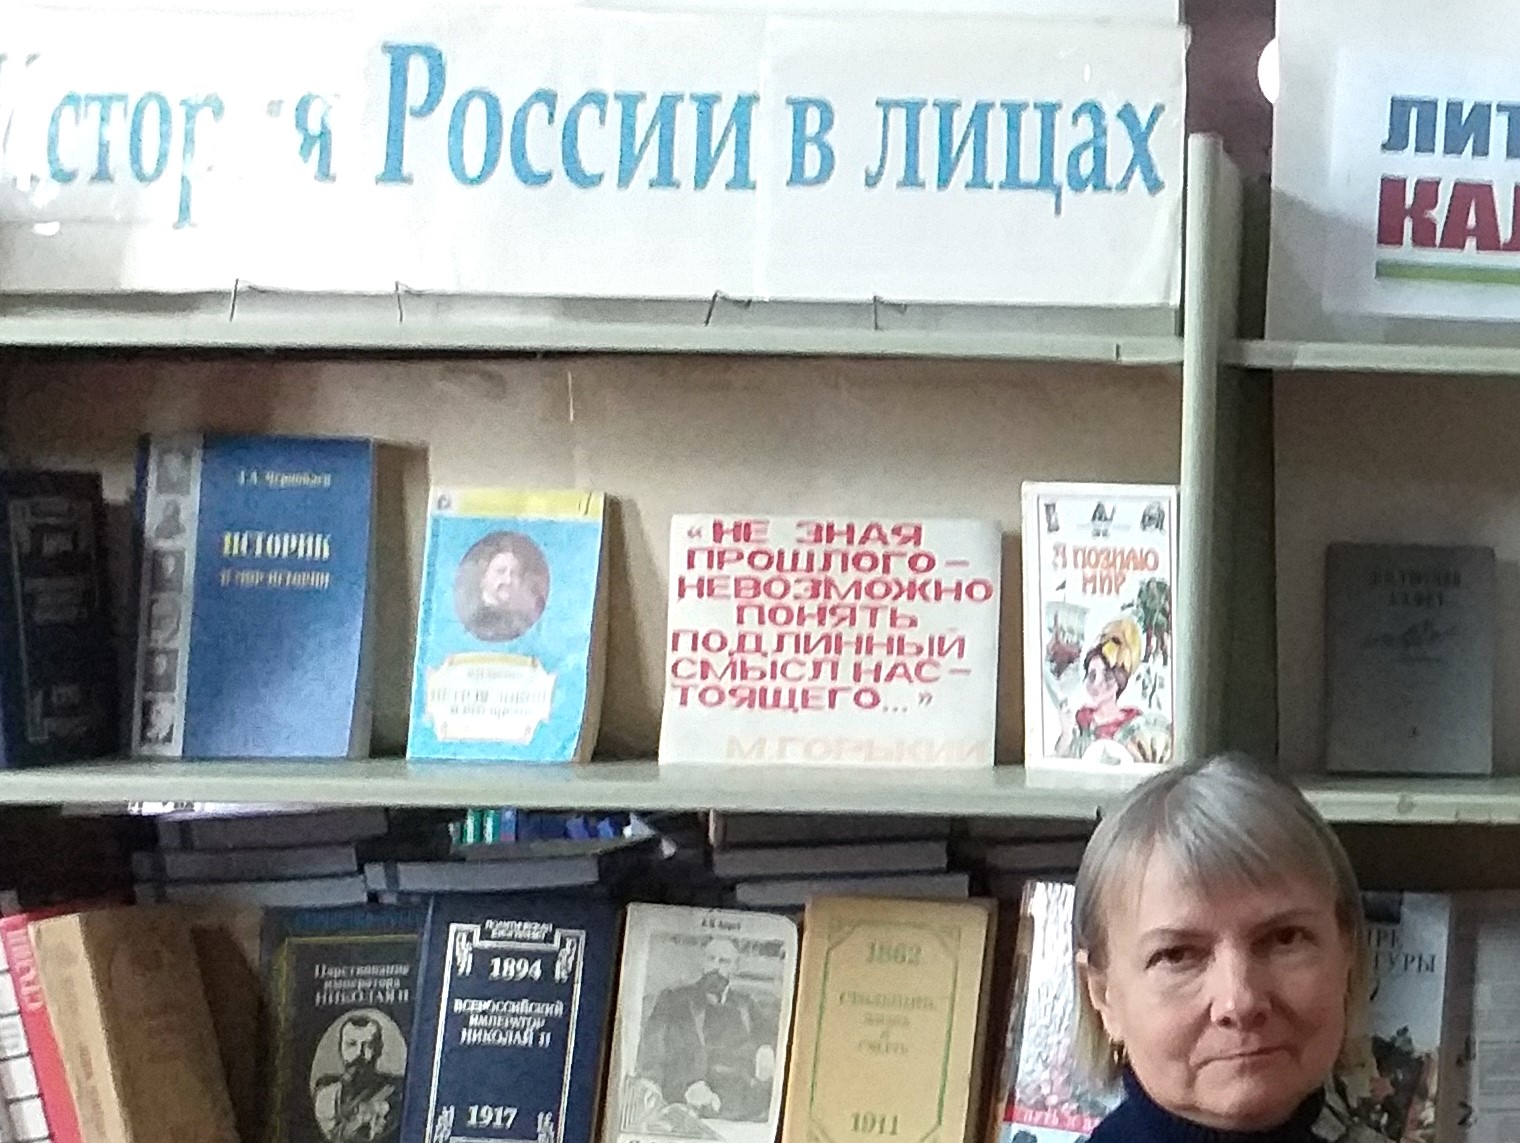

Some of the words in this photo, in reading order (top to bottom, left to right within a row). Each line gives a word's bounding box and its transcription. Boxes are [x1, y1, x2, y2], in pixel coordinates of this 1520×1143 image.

[376, 41, 760, 190] России
[787, 97, 835, 188] в
[864, 100, 1165, 216] лицах
[223, 530, 331, 560] ИСТОРИК
[797, 519, 923, 547] ЗНАЯ
[687, 547, 936, 575] ПРОШЛОГО
[1072, 544, 1160, 572] ПОЗНАЮ
[677, 575, 994, 602] НЕВОЗМОЖНО
[1082, 572, 1128, 596] МИР
[736, 603, 918, 628] ПОНЯТЬ
[671, 628, 966, 659] ПОДЛИННЫЙ
[671, 657, 839, 682] СМЫСЛ
[867, 941, 922, 966] 1862
[489, 956, 543, 981] 1894
[453, 998, 564, 1018] ВСЕРОССИЙСКИЙ
[468, 1012, 546, 1030] ИМПЕРАТОР
[460, 1028, 534, 1048] НИКОЛАЙ
[538, 1031, 552, 1048] II
[467, 1104, 518, 1130] 1917
[851, 1112, 898, 1136] 1911
